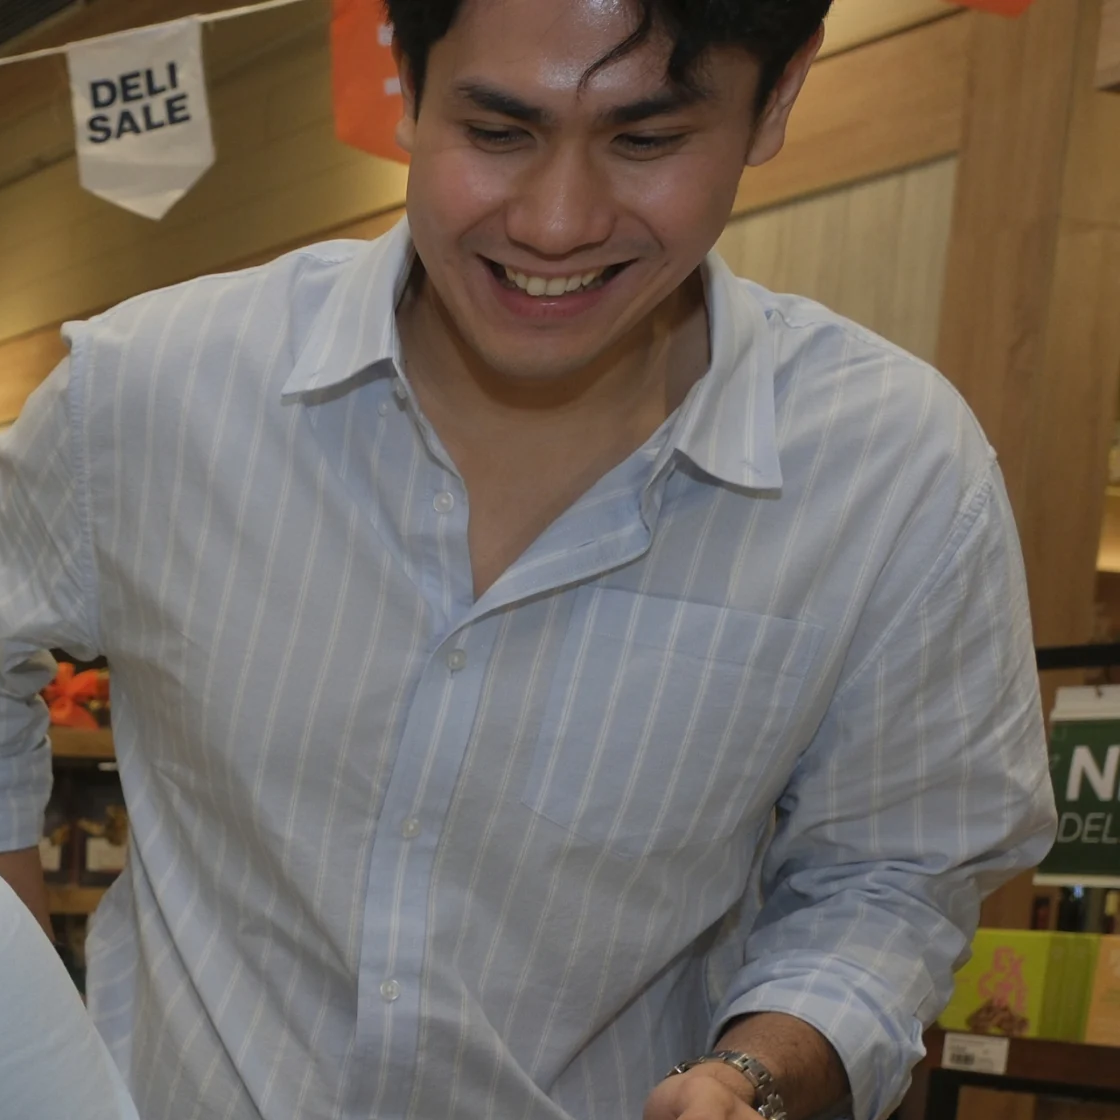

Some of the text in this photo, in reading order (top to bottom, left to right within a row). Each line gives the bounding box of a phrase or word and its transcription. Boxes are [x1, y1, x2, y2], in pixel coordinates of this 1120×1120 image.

[89, 61, 178, 109] DELI
[86, 92, 192, 144] SALE
[1066, 743, 1120, 801] N
